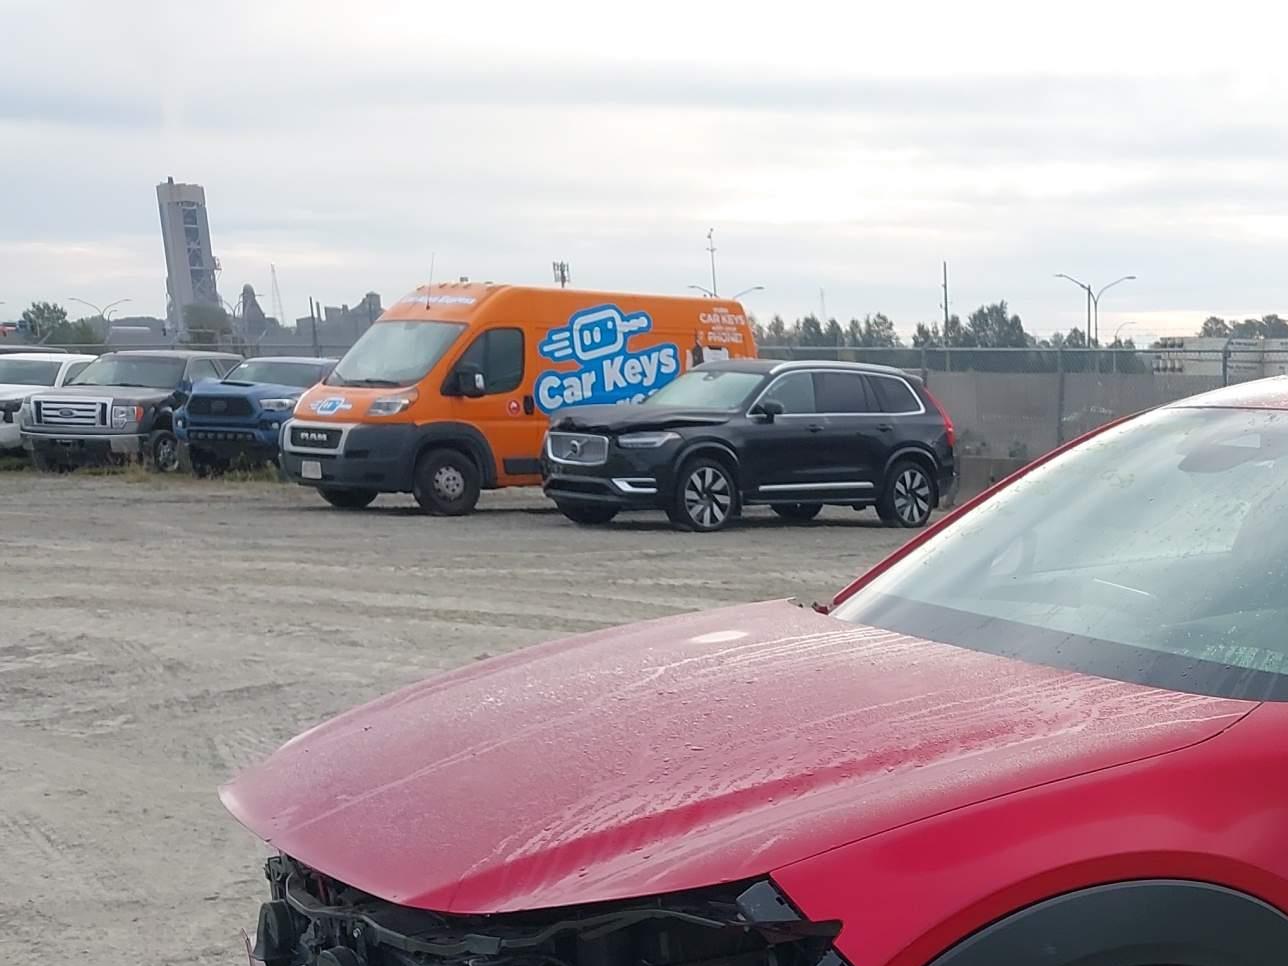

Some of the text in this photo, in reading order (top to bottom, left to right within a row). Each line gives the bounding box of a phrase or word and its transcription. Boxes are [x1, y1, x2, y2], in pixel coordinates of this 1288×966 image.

[538, 370, 597, 410] Car
[602, 347, 677, 392] Keys
[300, 432, 328, 441] RAM
